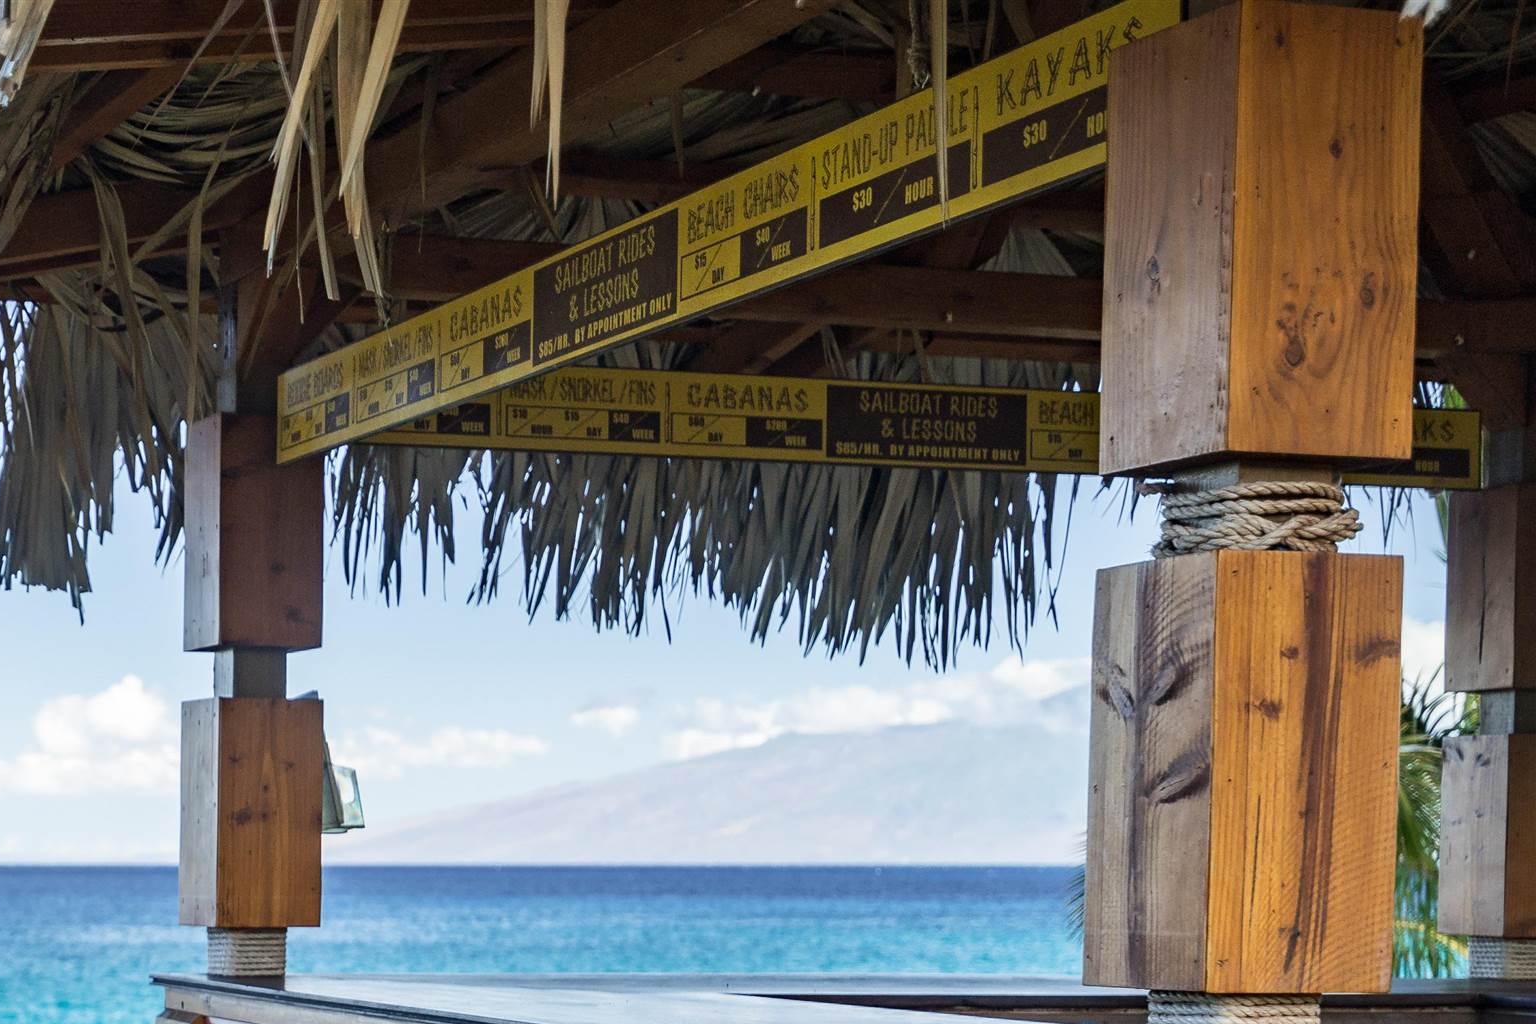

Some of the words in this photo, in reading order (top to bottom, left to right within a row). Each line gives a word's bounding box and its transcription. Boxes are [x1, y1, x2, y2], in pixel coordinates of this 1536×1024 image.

[822, 120, 898, 190] STAND-UP
[906, 88, 968, 156] PADLE
[1023, 120, 1047, 148] $30
[1087, 110, 1107, 138] HO
[688, 190, 734, 244] BEACH
[743, 164, 799, 220] CHAIRS
[853, 187, 872, 213] $30
[905, 176, 934, 205] HOUR
[555, 242, 613, 294] SAILBOAT
[618, 225, 655, 267] RIDES
[771, 240, 791, 261] WEEK
[712, 266, 725, 284] DAY
[569, 294, 579, 322] &
[584, 268, 639, 317] LESSONS
[450, 285, 522, 341] CABANAS
[575, 326, 585, 344] BY
[587, 302, 647, 339] APPOINTMENT
[649, 292, 672, 315] ONLY
[510, 376, 547, 401] MASK
[560, 376, 616, 403] SNORKEL
[629, 379, 656, 406] FINS
[688, 382, 809, 413] CABANAS
[859, 390, 943, 415] SAILBOAT
[950, 396, 998, 418] RIDES
[461, 421, 484, 432] WEEK
[1040, 400, 1095, 426] BEACH
[880, 418, 895, 438] &
[902, 418, 977, 443] LESSONS
[889, 444, 904, 456] BY
[908, 444, 988, 460] APPOINTMENT
[992, 448, 1020, 462] ONLY
